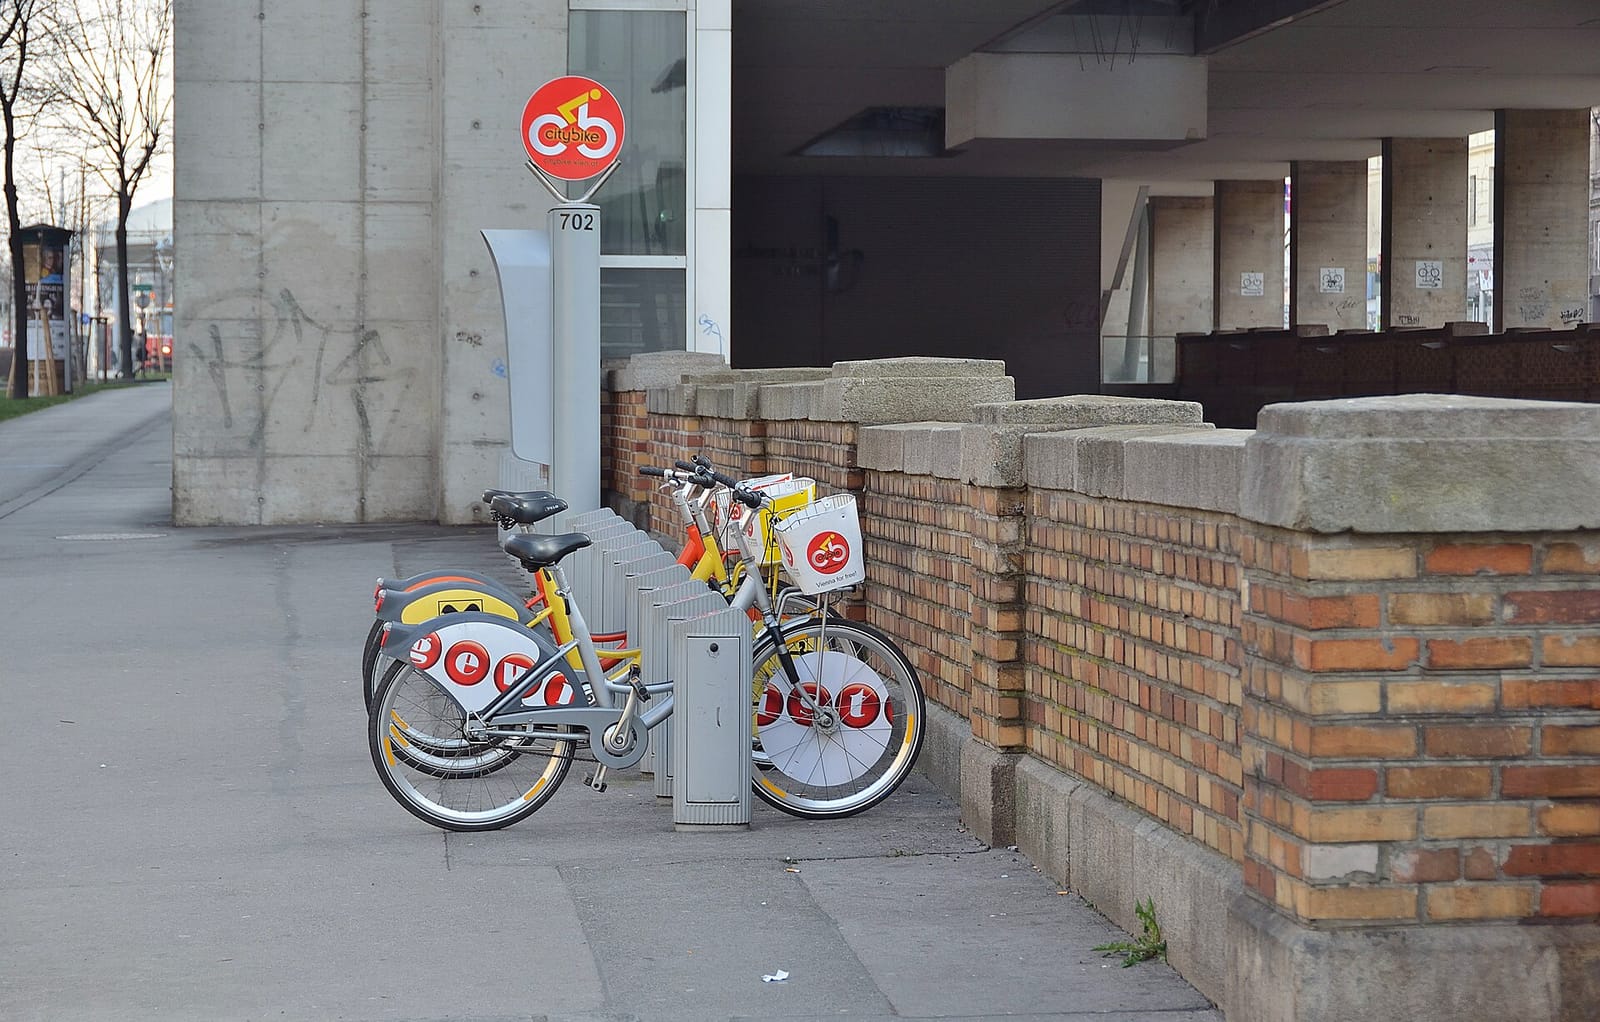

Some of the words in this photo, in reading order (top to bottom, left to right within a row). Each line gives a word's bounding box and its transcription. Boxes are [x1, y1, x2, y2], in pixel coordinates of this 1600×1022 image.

[545, 127, 600, 144] citybike
[560, 213, 594, 231] 702
[815, 577, 836, 588] Vienna
[836, 574, 844, 582] for
[844, 570, 857, 579] free!
